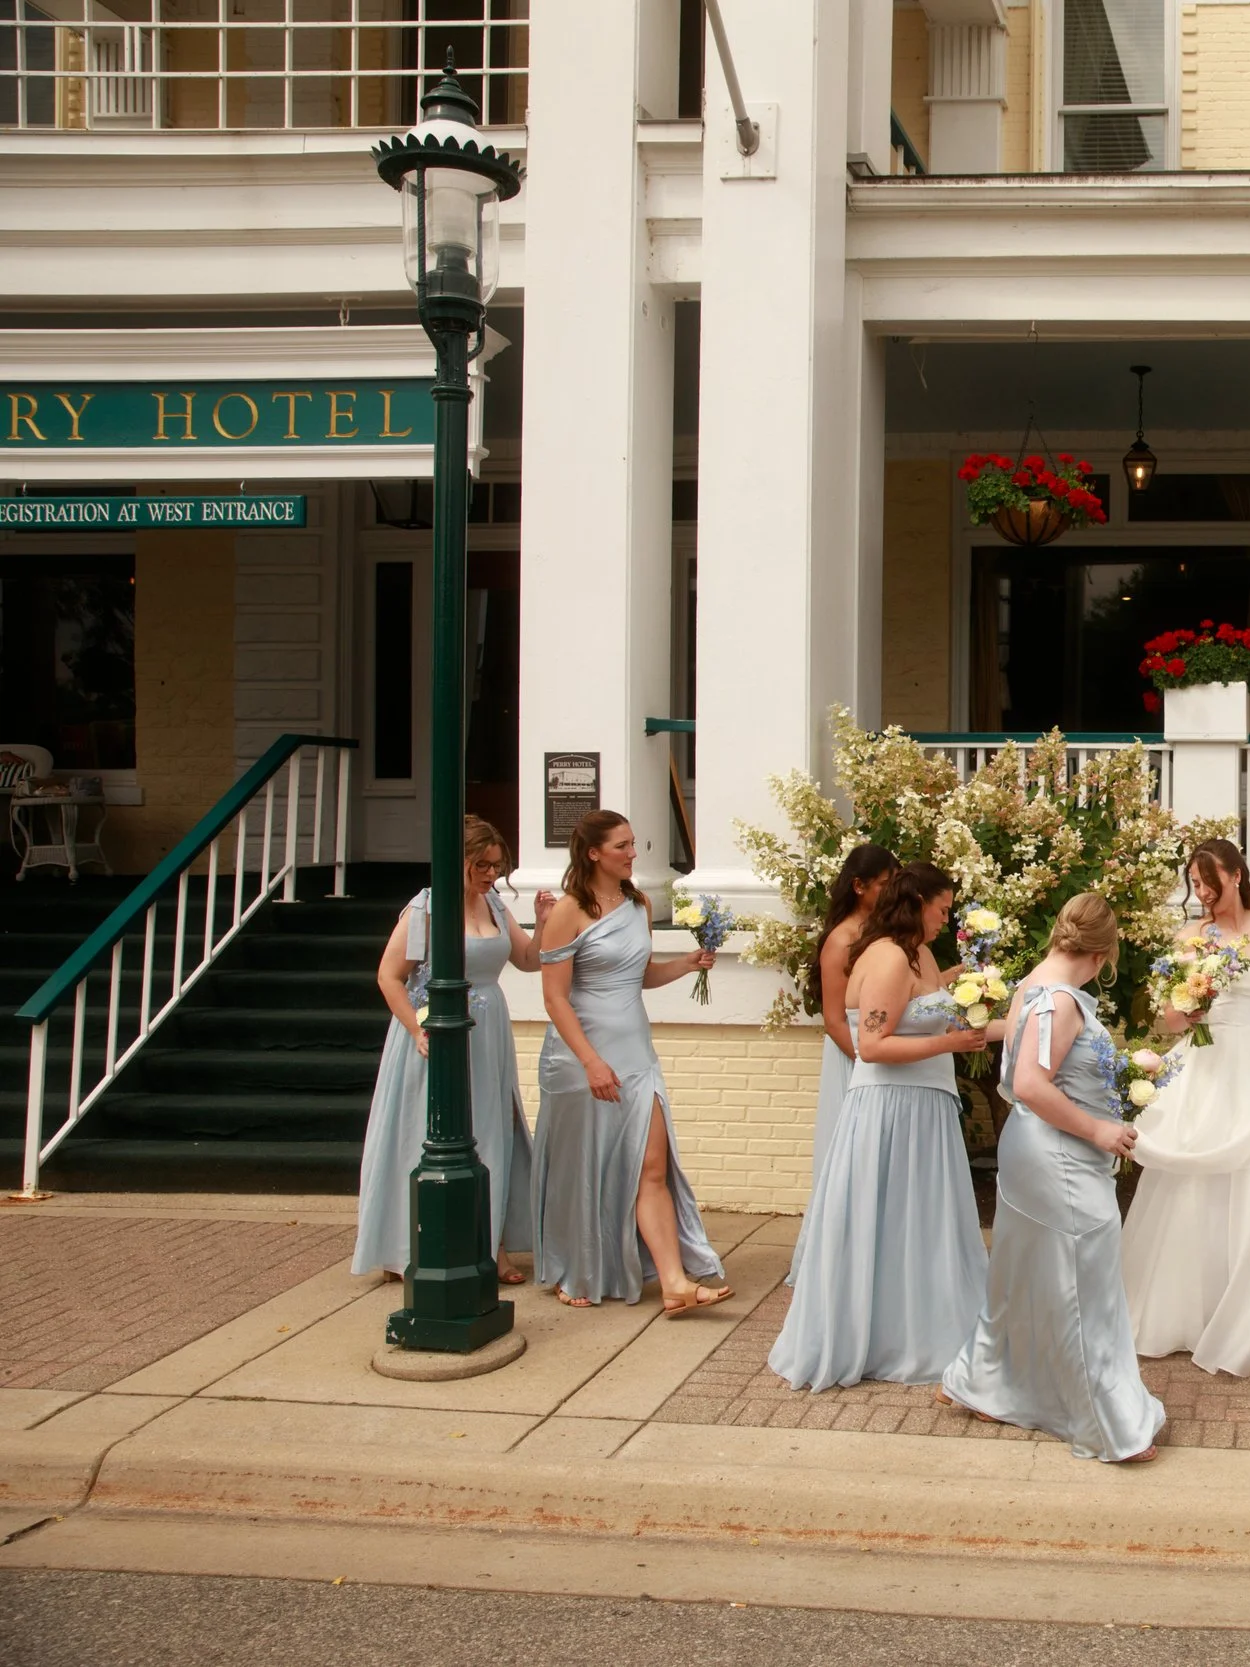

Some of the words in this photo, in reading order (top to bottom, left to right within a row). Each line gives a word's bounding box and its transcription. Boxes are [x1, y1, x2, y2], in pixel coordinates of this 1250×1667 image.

[151, 390, 413, 440] HOTEL
[117, 503, 140, 522] AT
[147, 502, 195, 521] WEST
[201, 501, 295, 521] ENTRANCE
